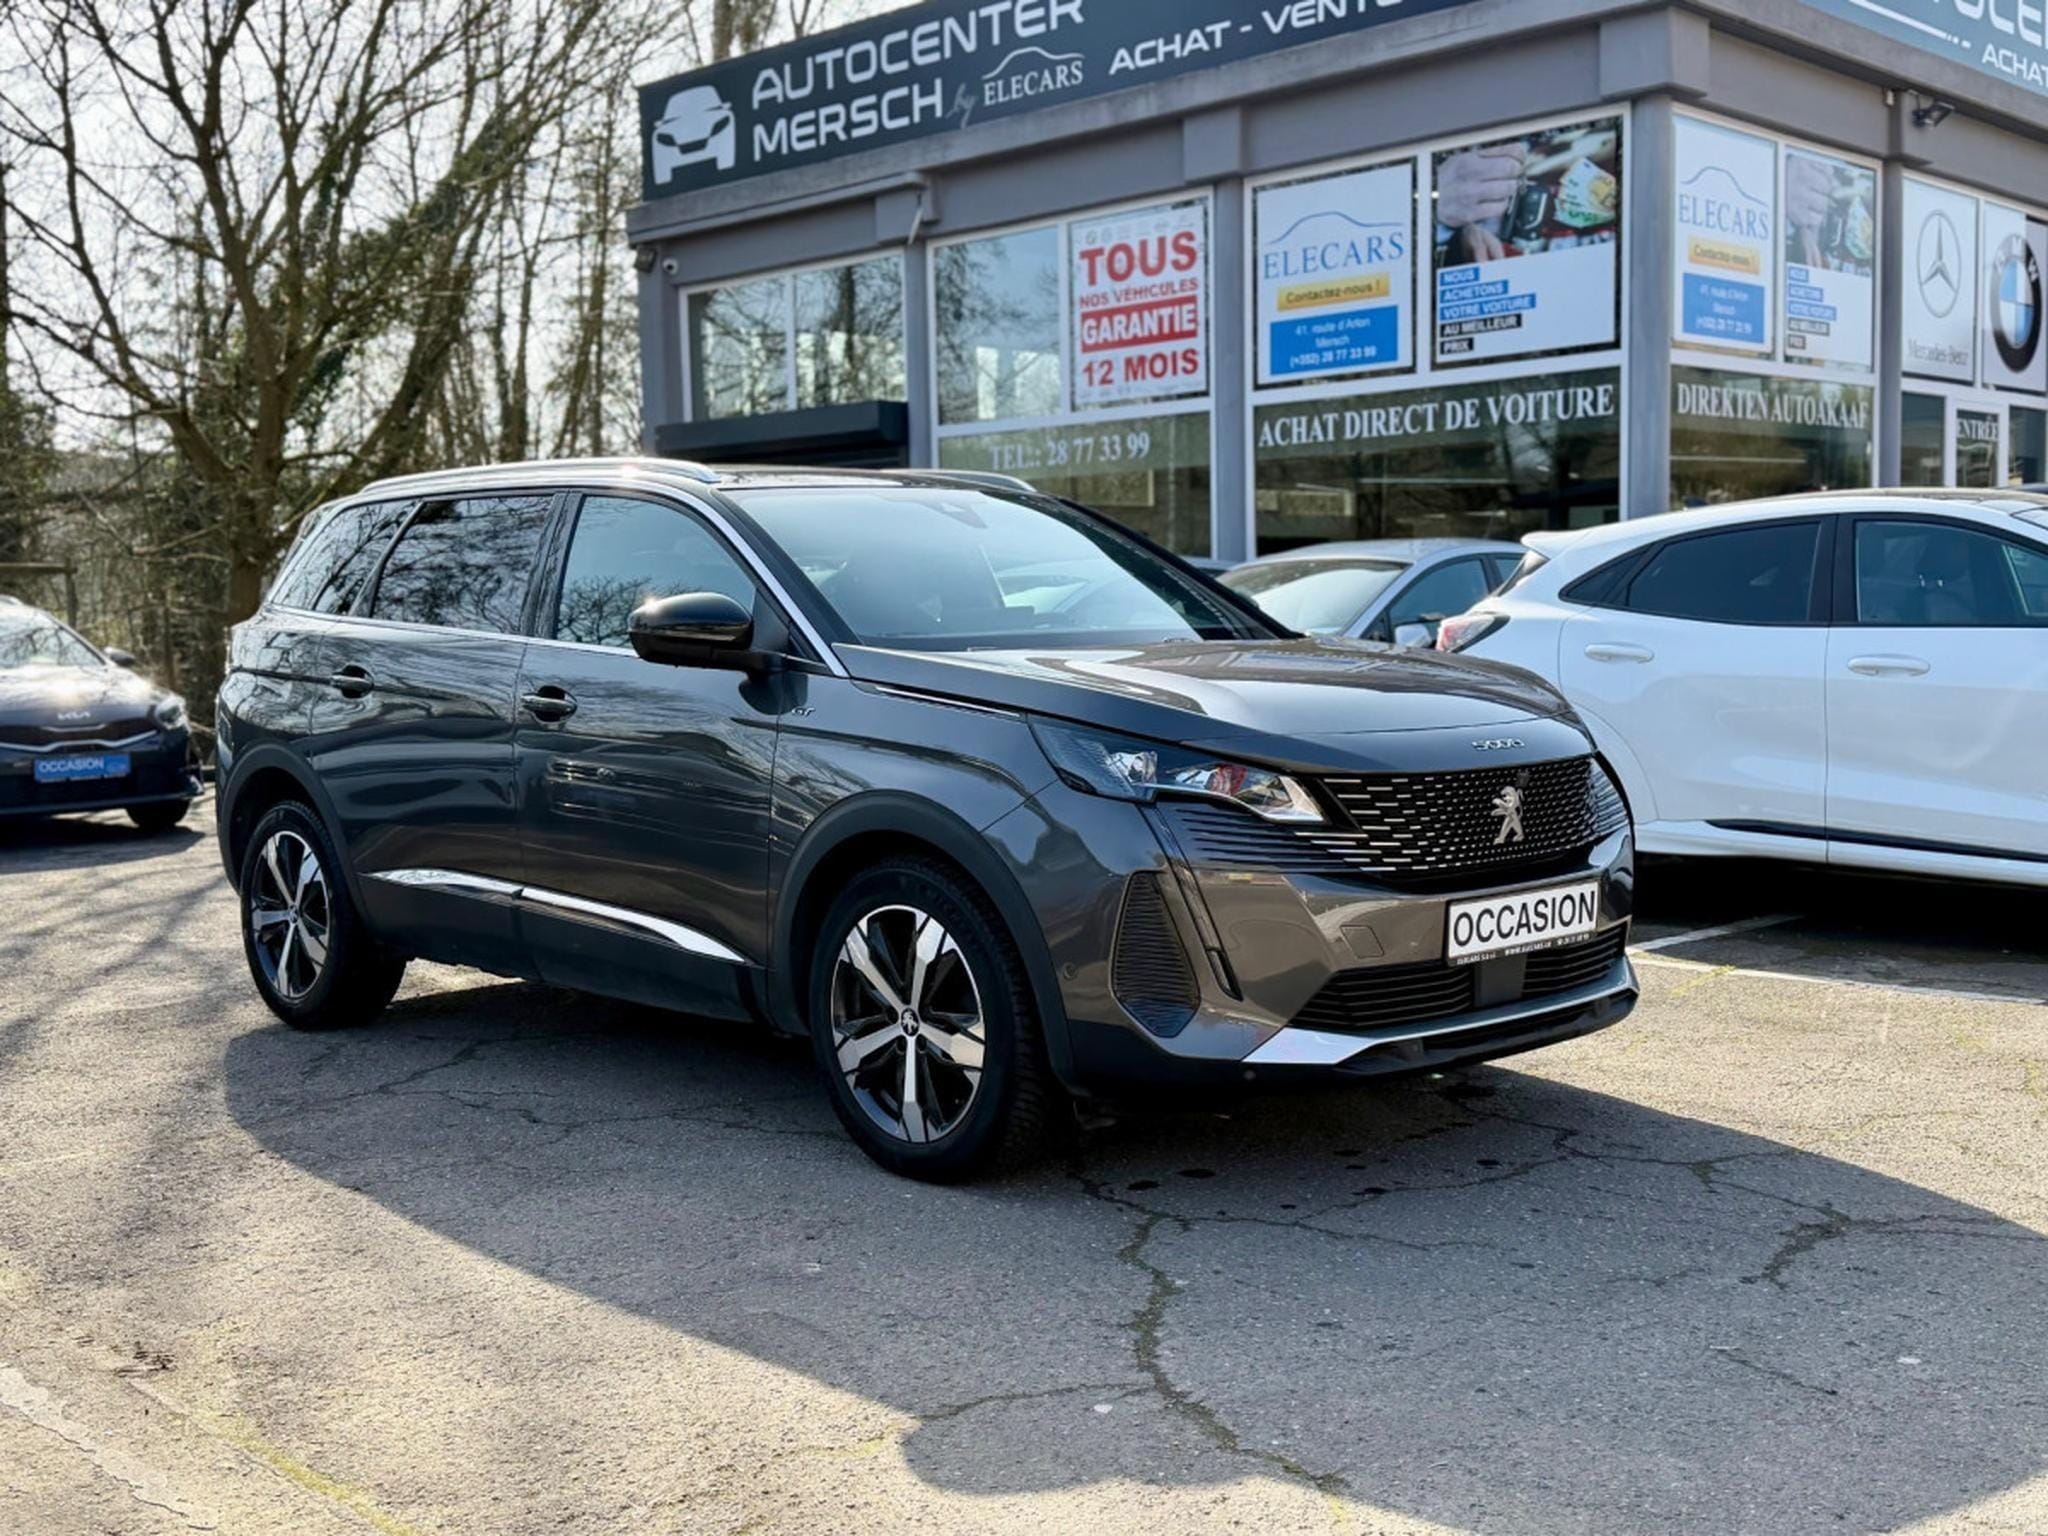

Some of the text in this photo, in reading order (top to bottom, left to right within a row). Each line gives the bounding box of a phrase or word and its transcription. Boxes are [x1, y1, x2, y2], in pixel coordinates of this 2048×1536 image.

[752, 0, 1085, 109] AUTOCENTER
[1109, 21, 1231, 75] ACHAT
[945, 60, 1084, 129] by ELECARS
[753, 78, 943, 161] MERSCH
[1679, 193, 1768, 240] ELECARS
[1079, 230, 1197, 287] TOUS
[1264, 231, 1404, 280] ELECARS
[1444, 269, 1474, 283] NOUS
[1080, 292, 1108, 308] NOS
[1443, 282, 1503, 301] ACHETONS
[1443, 302, 1479, 319] VOTRE
[1082, 304, 1196, 345] GARANTIE
[1444, 323, 1460, 336] AU
[1083, 348, 1199, 387] 12 MOIS
[1259, 384, 1614, 447] ACHAT DIRECT DE VOITURE
[1677, 383, 1768, 423] DIREKTEN
[1047, 438, 1068, 466] 28
[1073, 436, 1094, 464] 77
[1099, 434, 1121, 461] 33
[1127, 431, 1150, 459] 99
[39, 758, 104, 772] OCCASION
[1453, 891, 1595, 946] OCCASION
